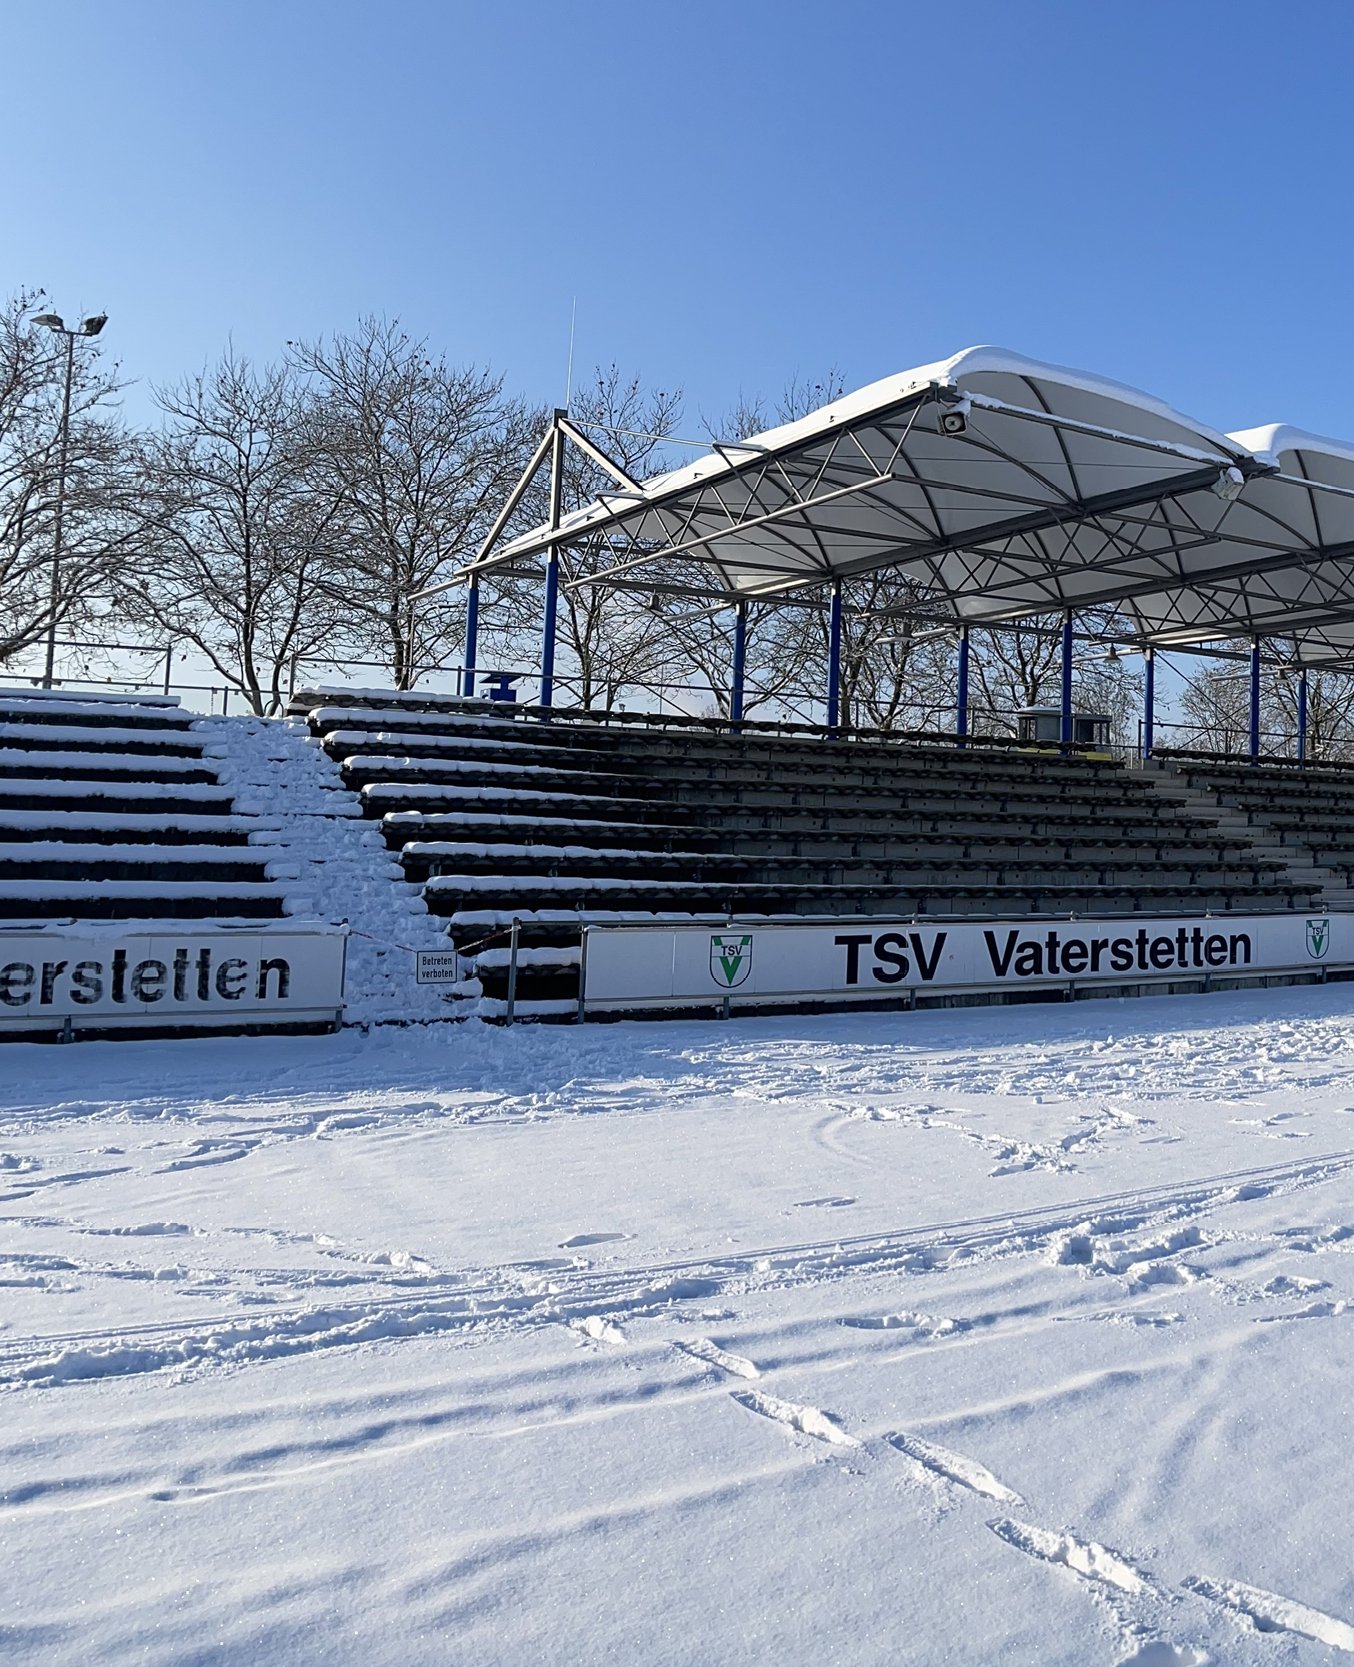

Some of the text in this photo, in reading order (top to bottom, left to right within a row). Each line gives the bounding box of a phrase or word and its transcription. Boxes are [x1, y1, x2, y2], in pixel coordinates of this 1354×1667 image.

[1312, 927, 1324, 935] TSV
[720, 945, 743, 956] TSV
[422, 956, 453, 966] Betreten
[834, 927, 1252, 985] TSV Vaterstetten
[421, 968, 453, 978] verboten
